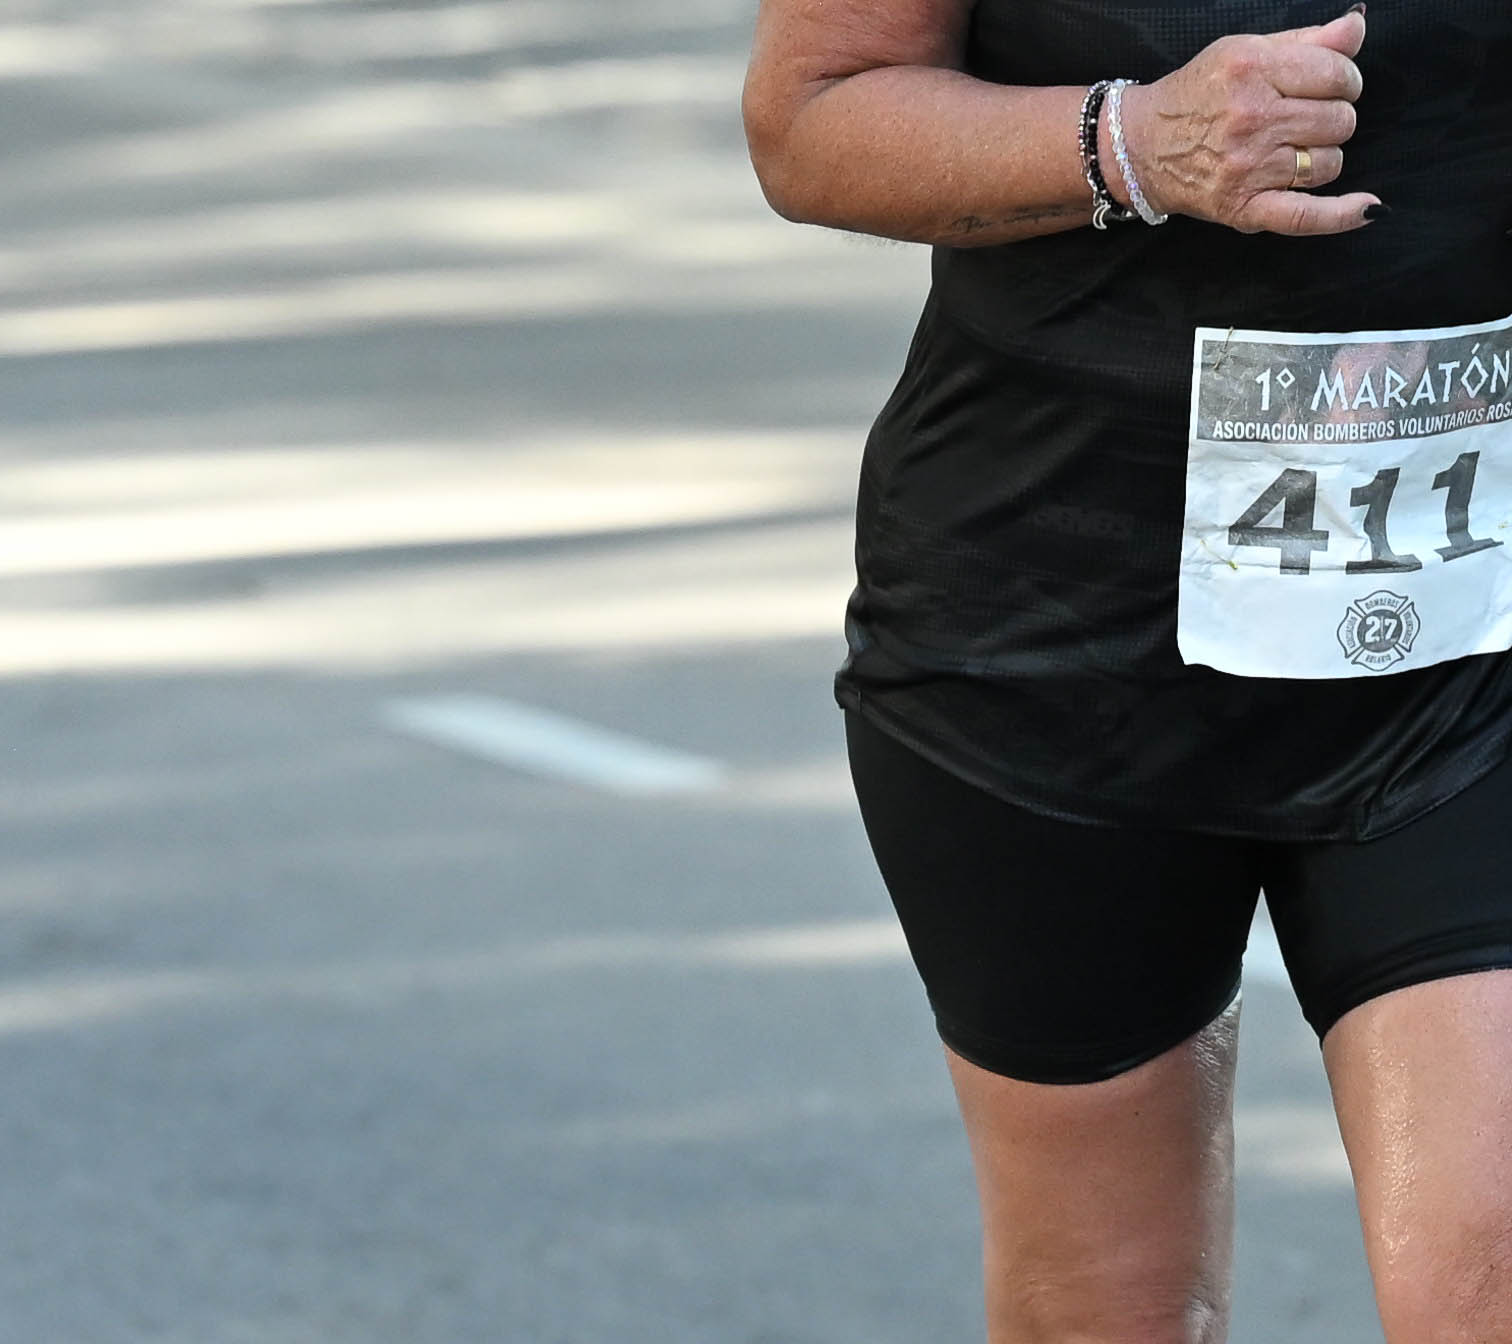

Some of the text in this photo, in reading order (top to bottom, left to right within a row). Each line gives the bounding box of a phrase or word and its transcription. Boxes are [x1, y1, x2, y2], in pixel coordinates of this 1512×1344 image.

[1311, 342, 1511, 412] MARATÓN
[1213, 419, 1308, 440] ASOCIACIÓN
[1314, 419, 1395, 440] BOMBEROS
[1399, 408, 1484, 436] VOLUNTARIOS
[1228, 451, 1504, 575] 411
